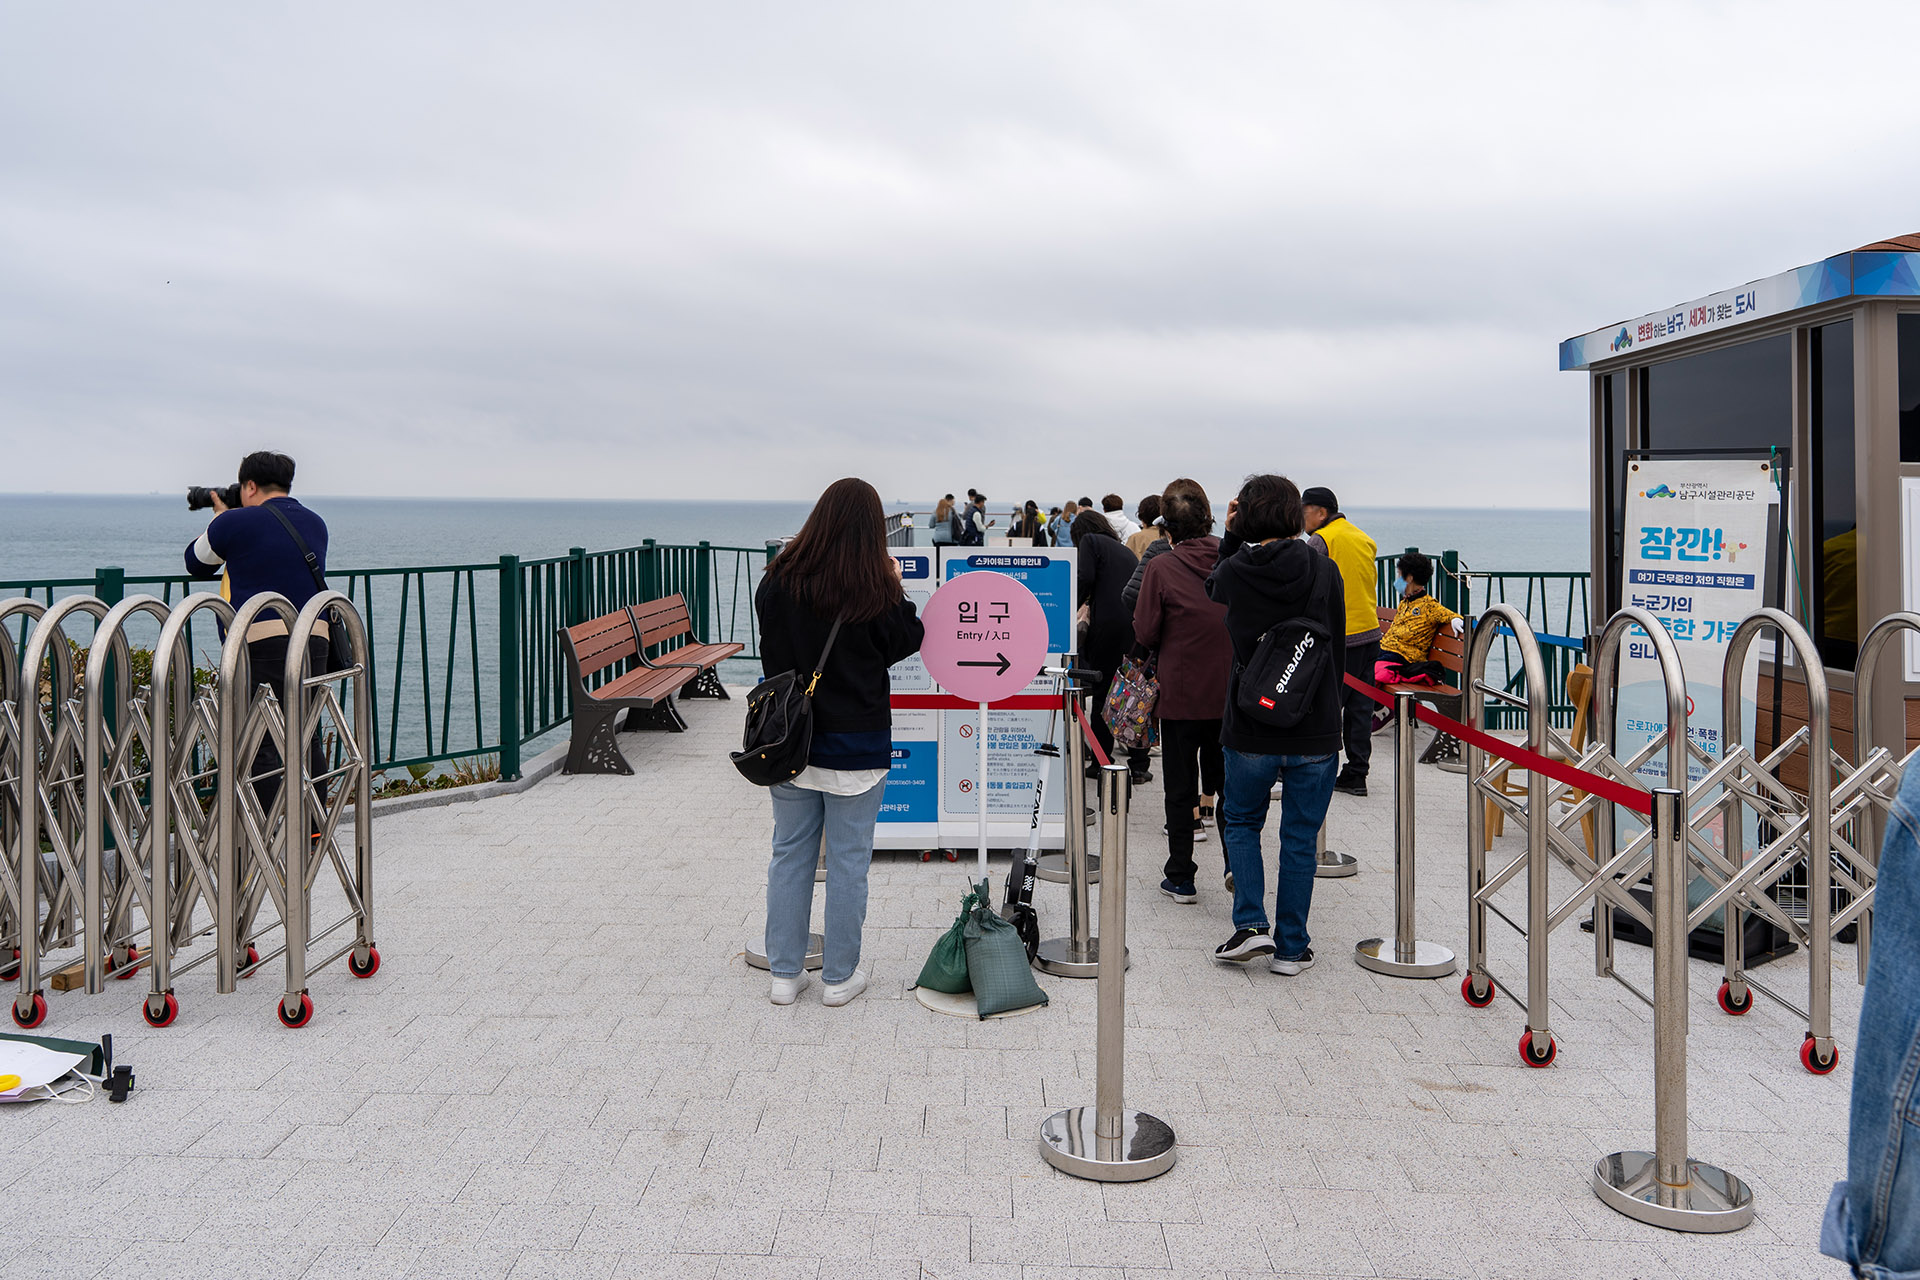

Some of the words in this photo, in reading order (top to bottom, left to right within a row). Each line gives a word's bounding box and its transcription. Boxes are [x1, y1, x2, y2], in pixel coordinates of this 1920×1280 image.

[1638, 321, 1666, 342] 변화하는
[1667, 312, 1686, 334] 남구,
[1689, 305, 1715, 327] 세계가
[1717, 303, 1732, 320] 찾는
[1735, 290, 1756, 315] 도시
[1679, 490, 1755, 501] 남구시설관리공단
[1640, 526, 1723, 562] 잠깐!
[976, 557, 1011, 566] 스카이워크
[1013, 557, 1042, 566] 이용안내
[1637, 572, 1655, 582] 여기
[1657, 573, 1694, 584] 근무중인
[1695, 575, 1714, 585] 저희
[1716, 576, 1745, 586] 직원은
[1631, 594, 1692, 613] 누군가의
[957, 630, 982, 641] Entry
[992, 631, 1010, 640] 入口
[1629, 643, 1657, 660] 입니
[1276, 632, 1315, 693] Supreme
[1001, 734, 1036, 742] 우산(양산),
[1687, 726, 1718, 741] 언·폭행
